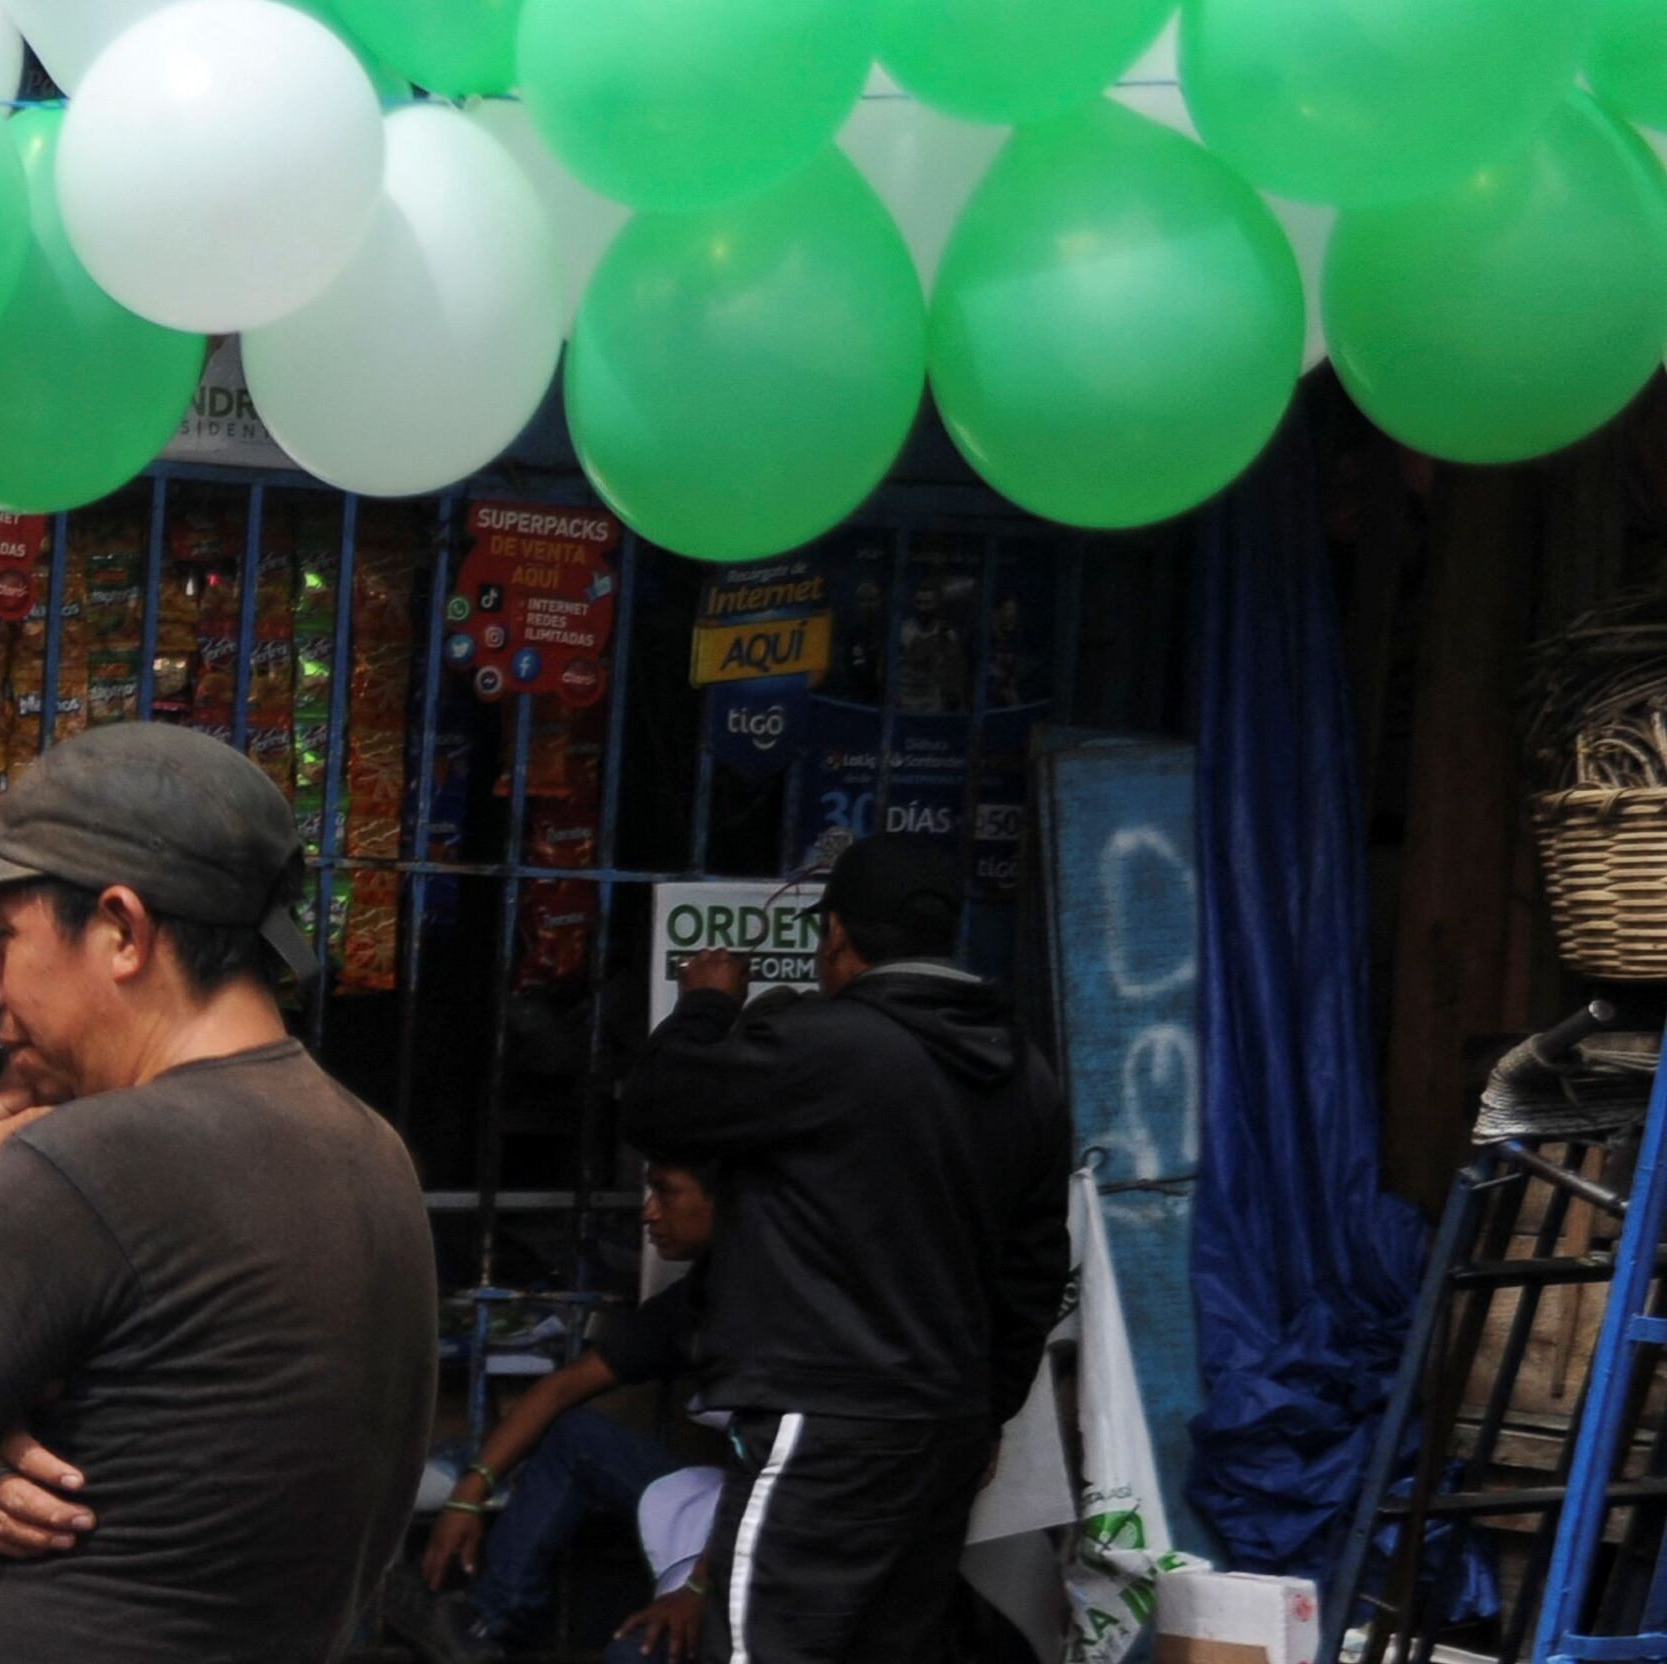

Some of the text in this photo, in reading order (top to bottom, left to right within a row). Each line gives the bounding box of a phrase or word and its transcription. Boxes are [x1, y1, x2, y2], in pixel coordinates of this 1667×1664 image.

[478, 508, 609, 542] SUPERPACKS
[490, 536, 587, 564] DE VENTA
[527, 598, 590, 616] INTERNET
[708, 576, 824, 616] Internet
[526, 613, 567, 628] REDES
[524, 628, 595, 647] ILIMITADAS
[718, 619, 806, 673] AQUÍ
[886, 799, 952, 834] DÍAS
